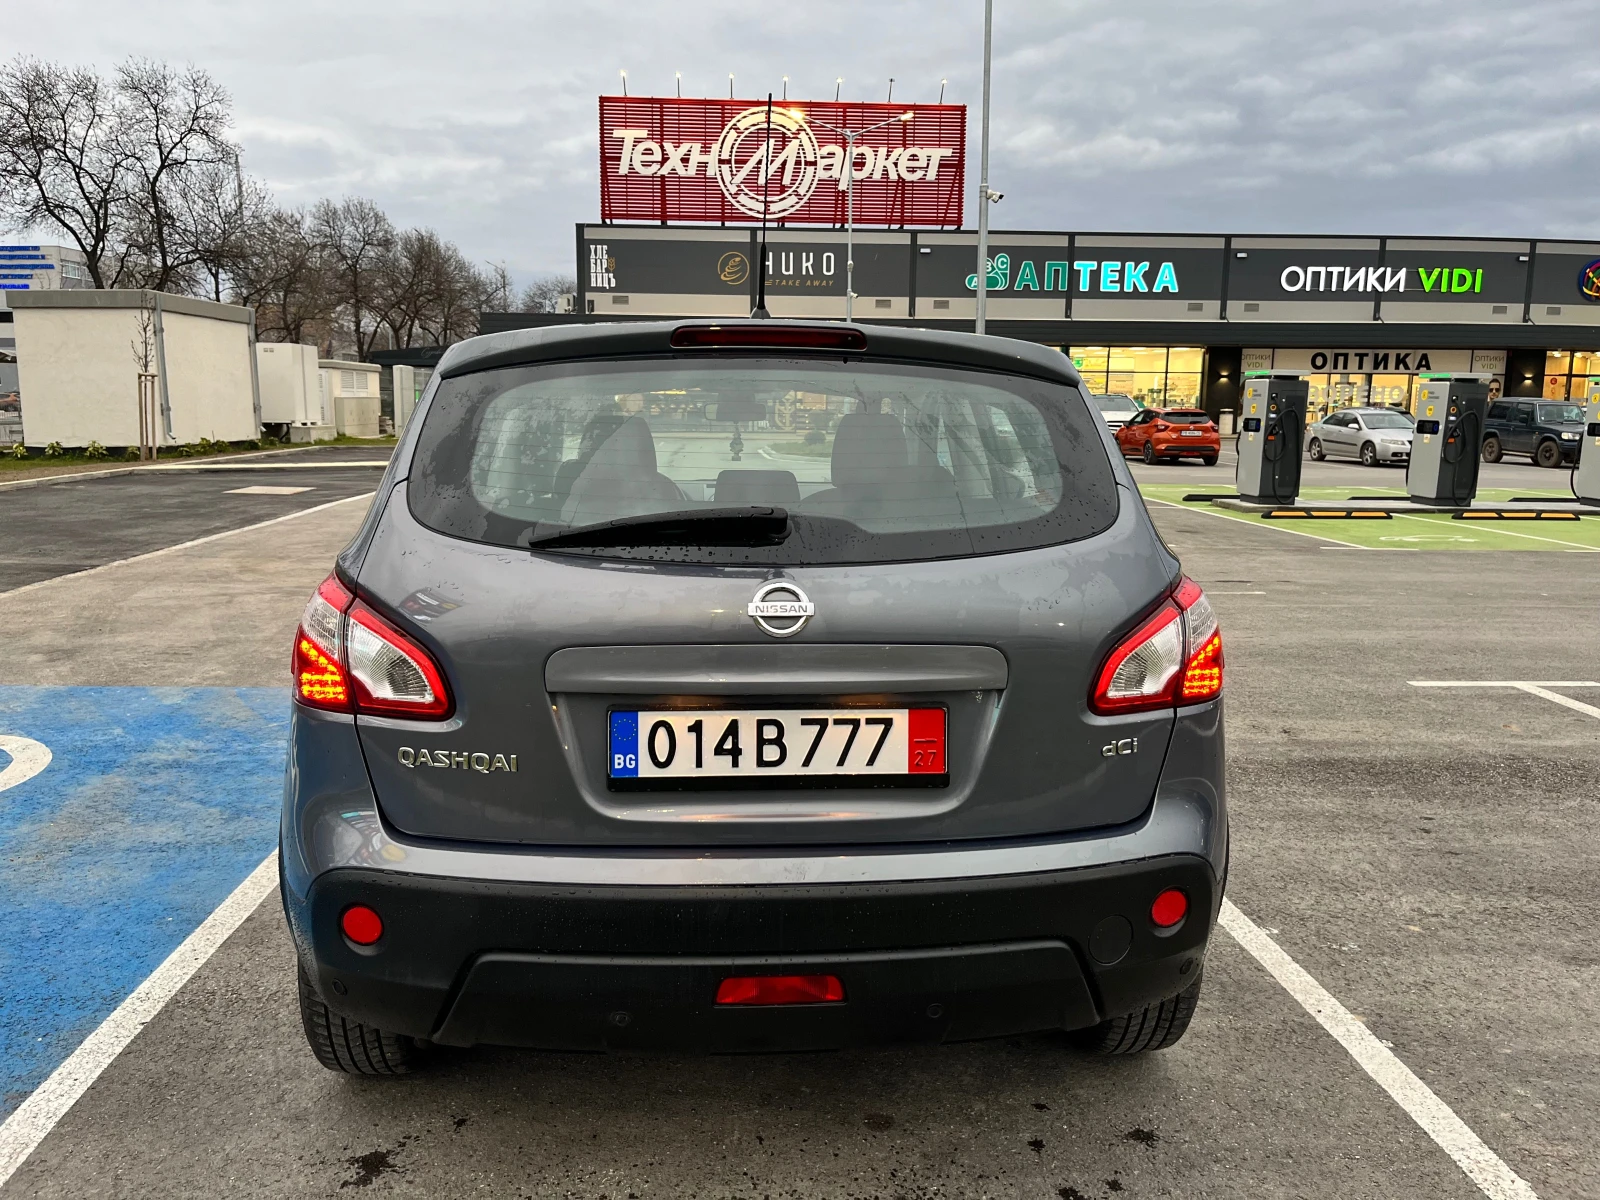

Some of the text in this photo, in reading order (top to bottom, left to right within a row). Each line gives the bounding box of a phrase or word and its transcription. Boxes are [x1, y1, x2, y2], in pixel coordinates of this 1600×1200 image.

[1014, 260, 1179, 293] АПТЕКА
[1280, 265, 1484, 293] ОПТИКИ VIDI
[1310, 352, 1432, 371] ОПТИКА
[754, 604, 808, 614] NISSAN
[1102, 737, 1138, 757] dCi
[397, 746, 518, 774] QASHQAI
[614, 753, 636, 770] BG
[914, 749, 937, 766] 27
